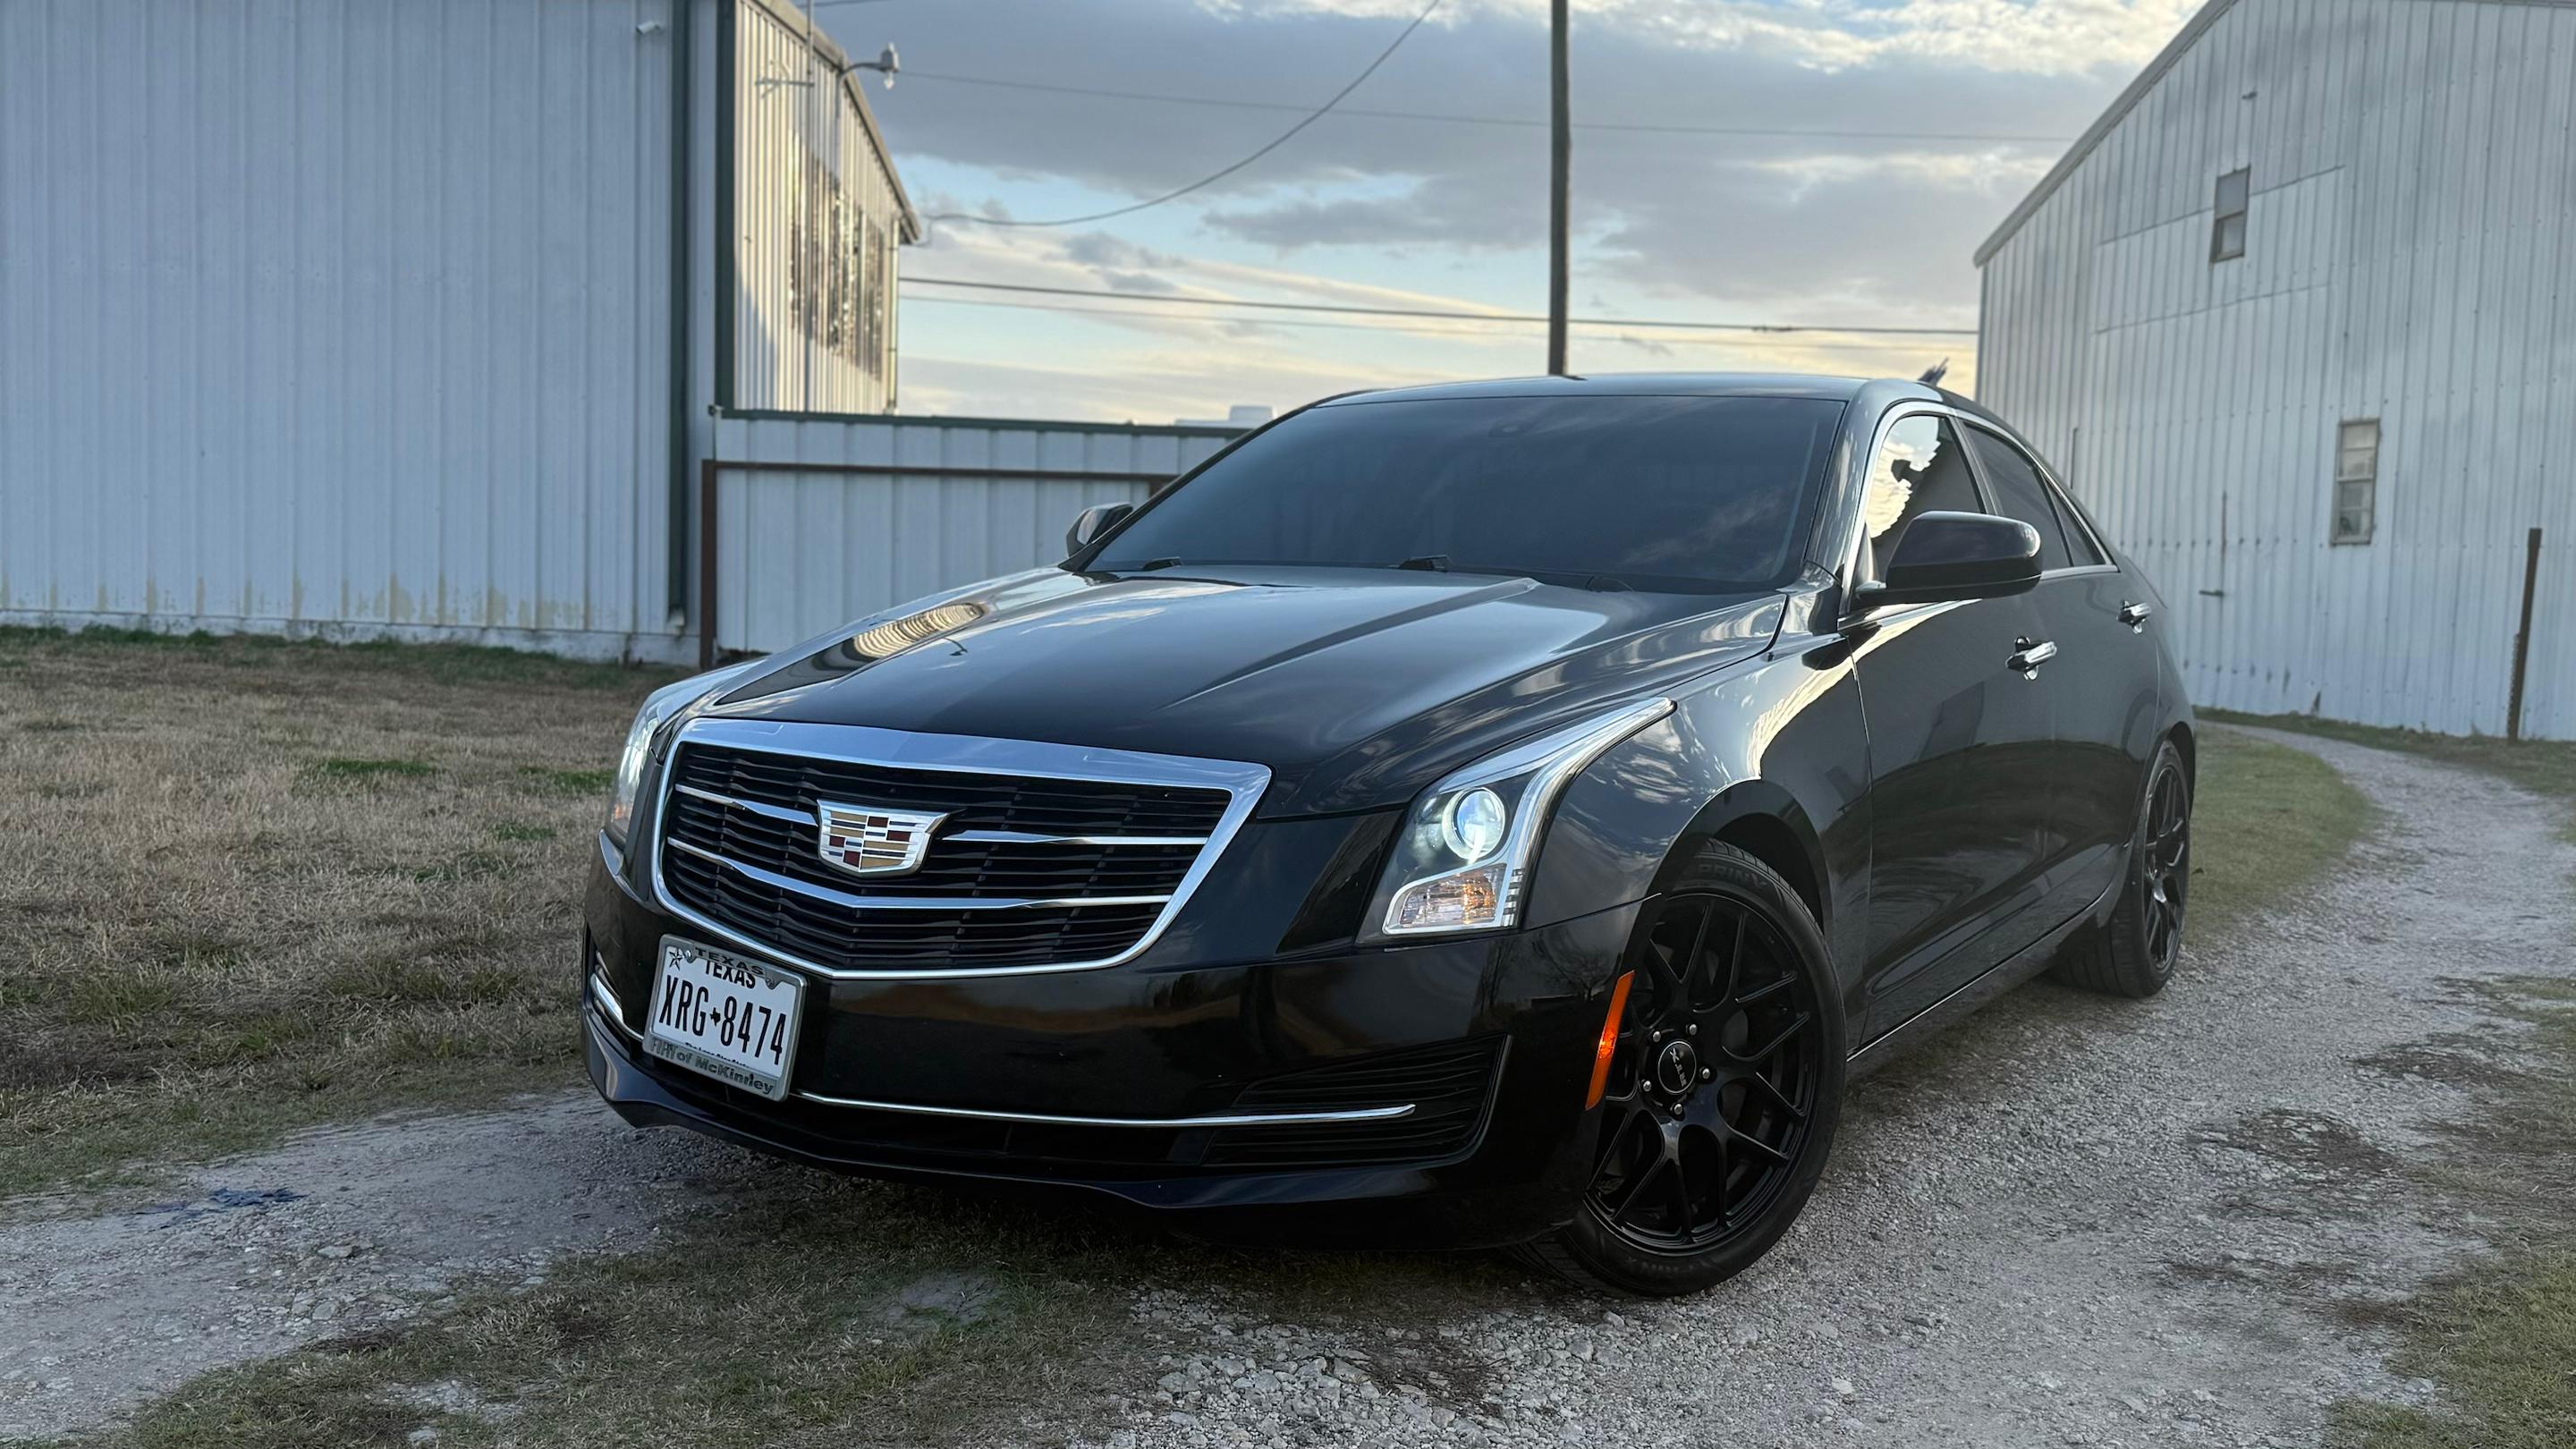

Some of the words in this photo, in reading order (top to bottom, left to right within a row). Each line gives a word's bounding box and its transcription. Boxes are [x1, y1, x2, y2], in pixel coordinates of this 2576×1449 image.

[695, 947, 764, 975] TEXAS
[705, 960, 756, 988] TEXAS
[659, 975, 708, 1037] XRG
[720, 996, 787, 1065] 8474
[676, 1050, 692, 1064] of
[695, 1055, 774, 1094] McKinney
